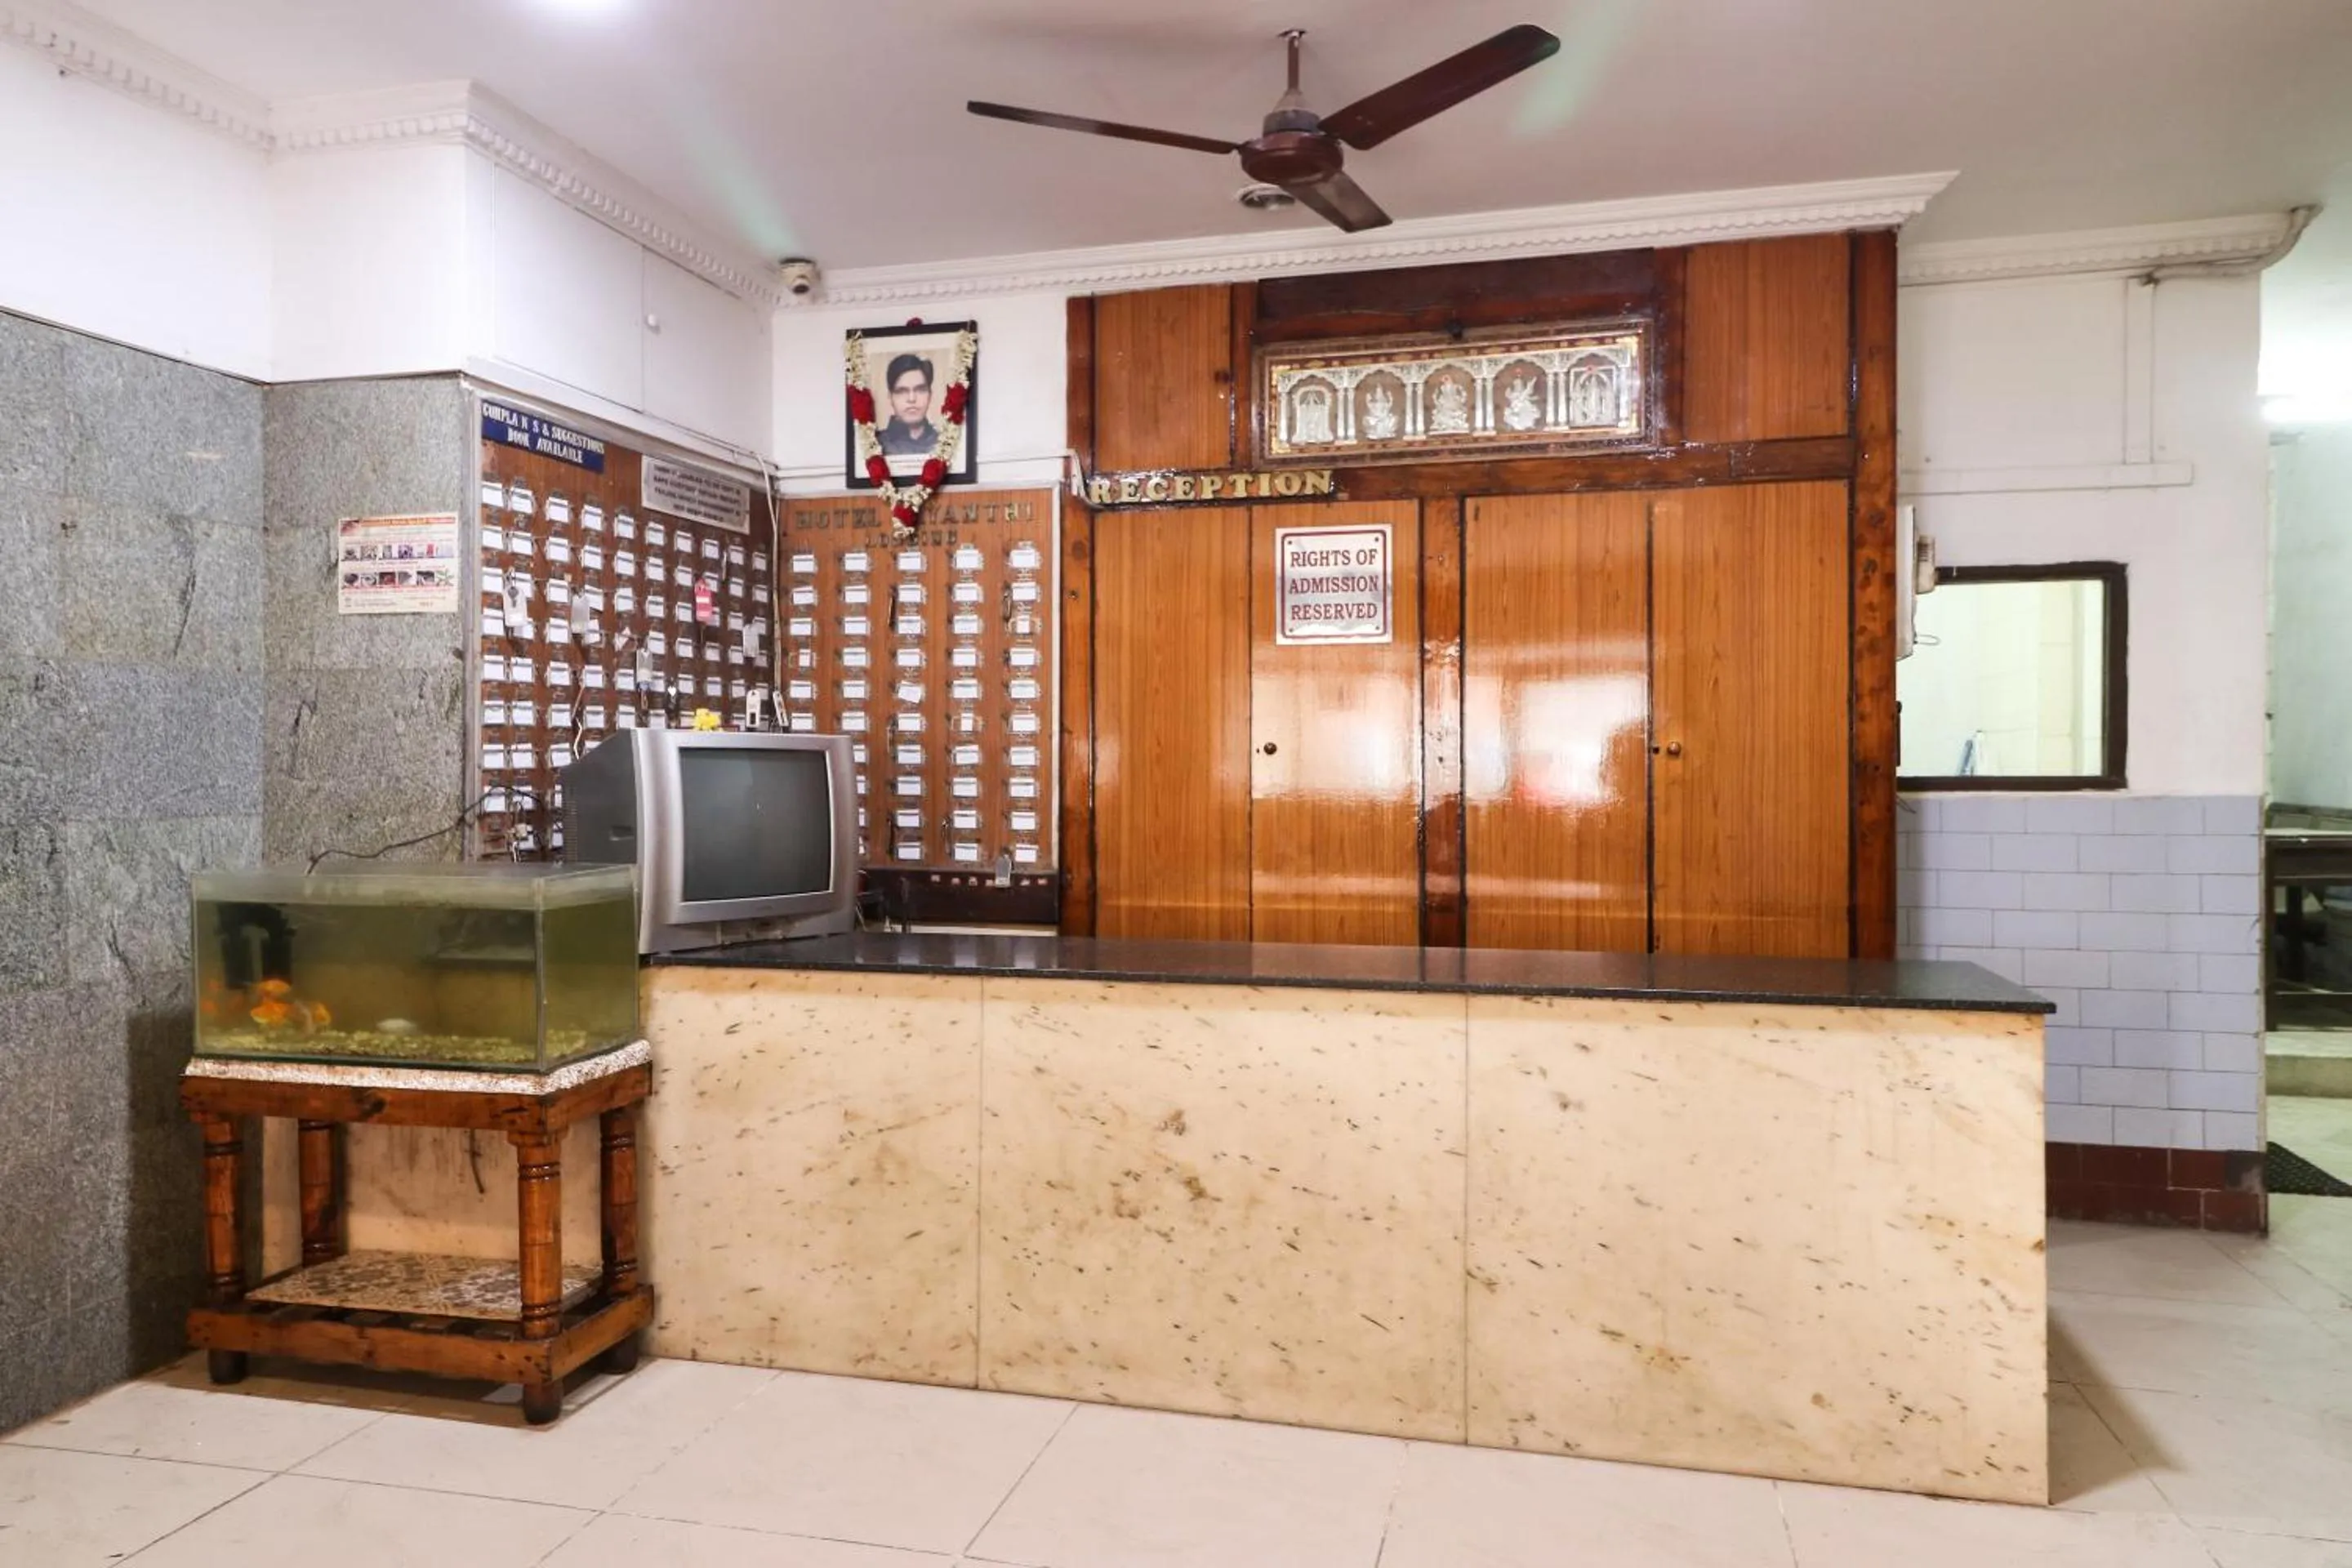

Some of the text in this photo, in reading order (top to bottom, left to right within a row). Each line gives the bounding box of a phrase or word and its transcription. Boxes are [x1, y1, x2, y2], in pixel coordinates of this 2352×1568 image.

[537, 438, 583, 463] AVAILABLE
[1089, 469, 1334, 505] RECEPTION
[795, 508, 881, 528] HOTEL
[1290, 549, 1379, 568] RIGHTS OF
[1289, 575, 1379, 595] ADMISSION
[1291, 603, 1378, 621] RESERVED
